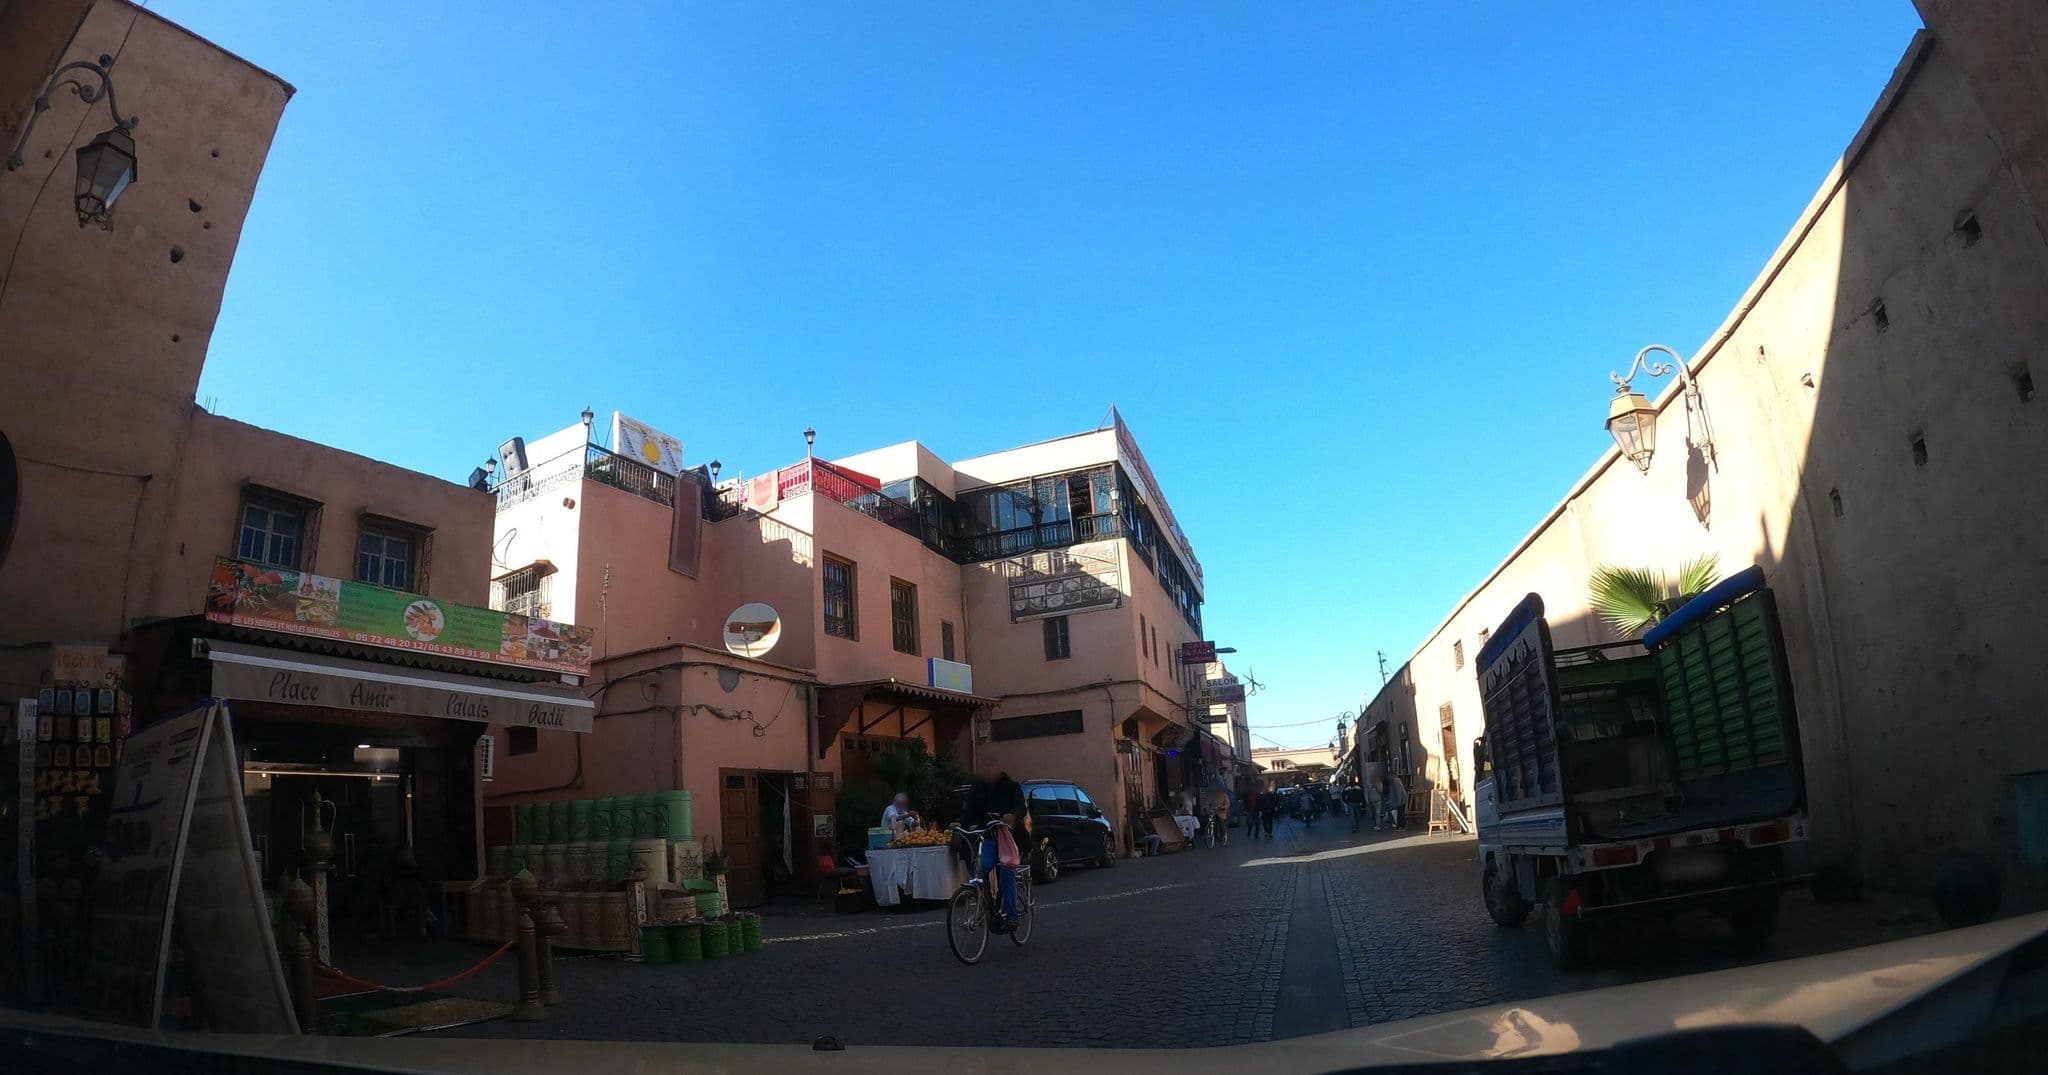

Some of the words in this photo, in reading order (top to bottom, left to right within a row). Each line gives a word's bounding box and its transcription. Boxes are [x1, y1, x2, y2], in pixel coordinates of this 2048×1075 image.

[368, 635, 382, 644] 72
[398, 639, 410, 648] 20
[1206, 678, 1237, 688] SALON
[268, 671, 320, 702] Place
[350, 681, 394, 709] Amir
[445, 692, 489, 719] Palais
